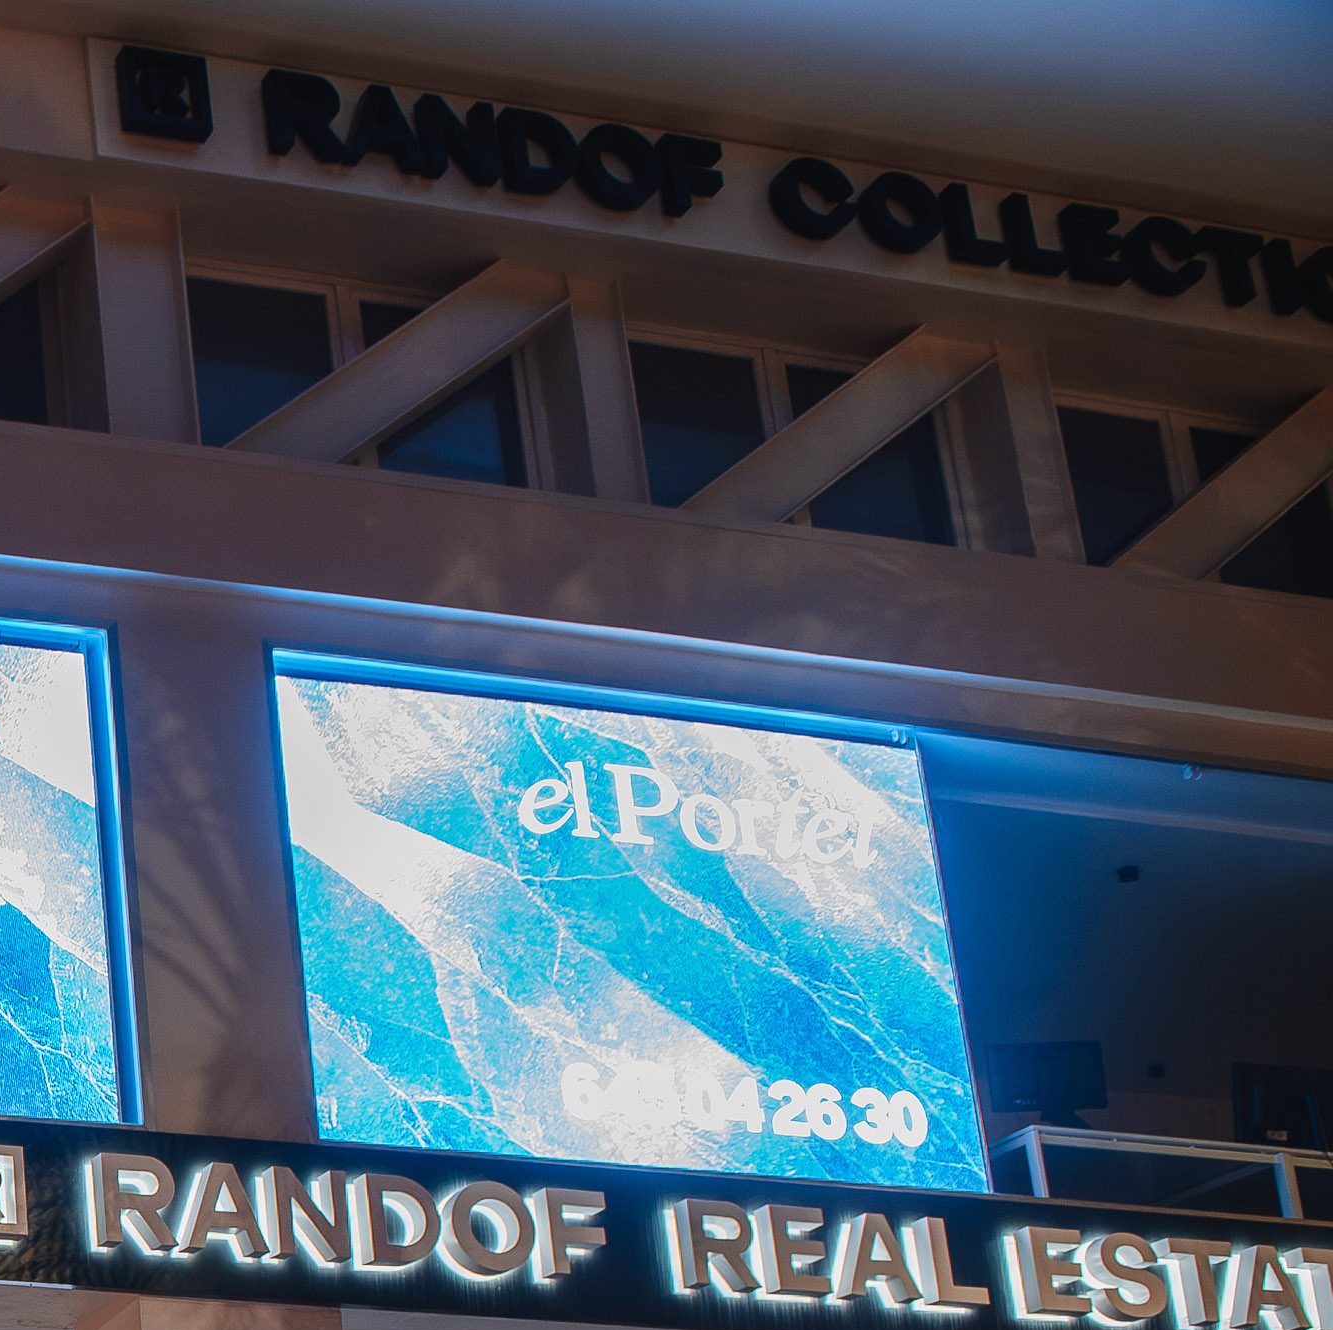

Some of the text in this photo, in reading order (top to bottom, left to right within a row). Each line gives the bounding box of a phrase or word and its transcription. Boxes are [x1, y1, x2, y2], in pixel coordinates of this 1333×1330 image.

[261, 68, 724, 218] RANDOF
[767, 1079, 845, 1141] 26
[852, 1086, 929, 1148] 30
[90, 1152, 607, 1282] RANDOF
[674, 1199, 992, 1308] REAL
